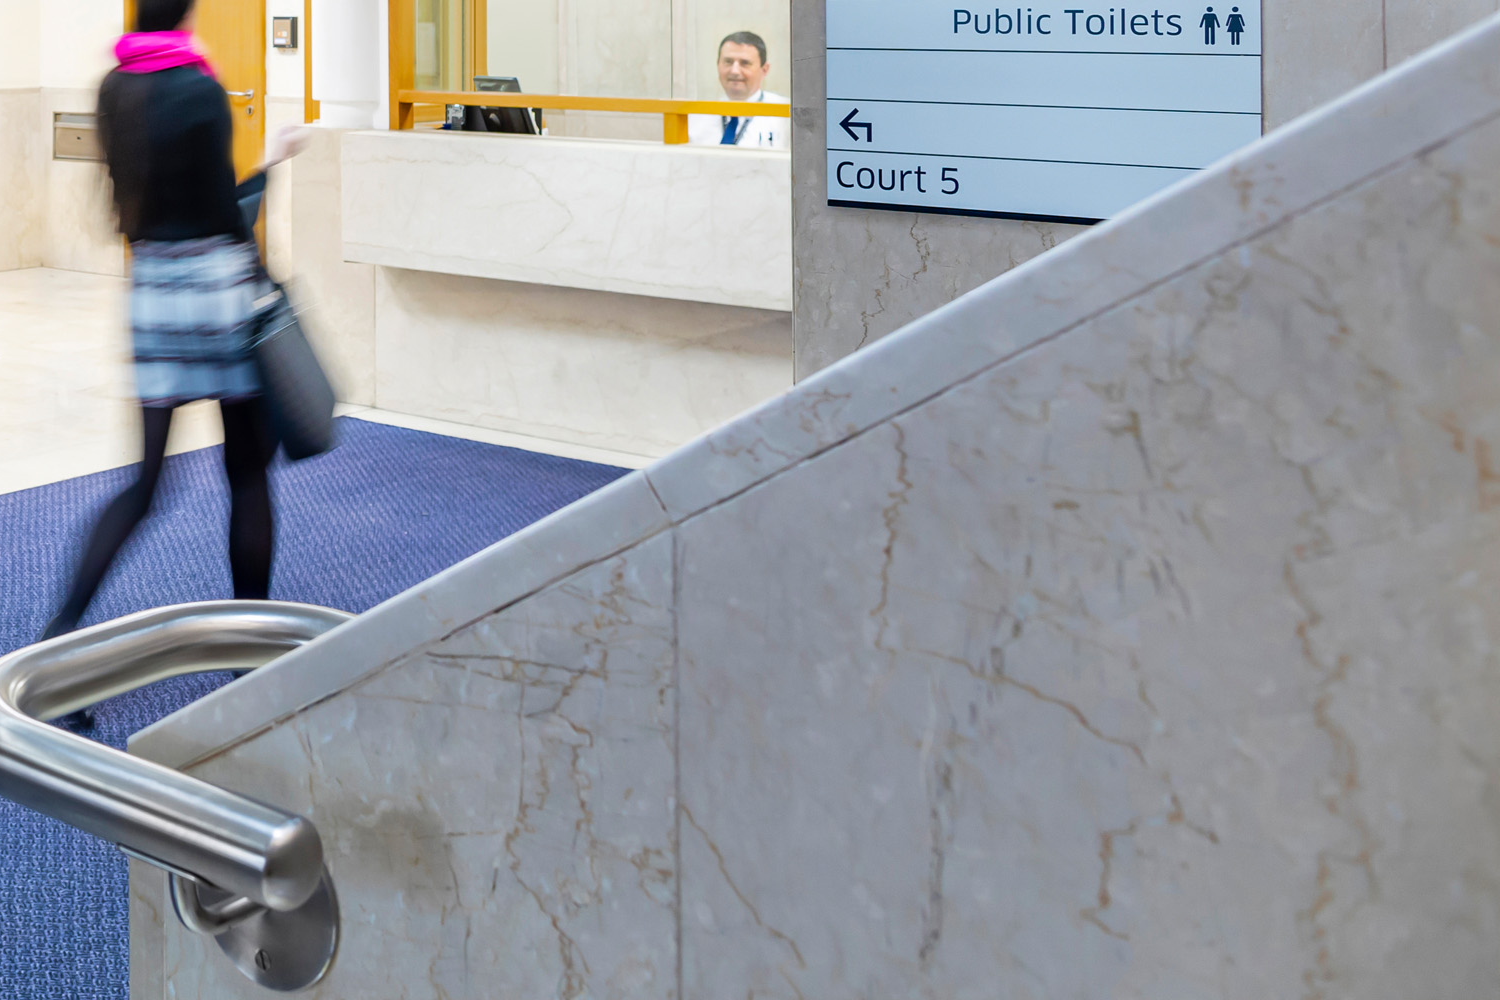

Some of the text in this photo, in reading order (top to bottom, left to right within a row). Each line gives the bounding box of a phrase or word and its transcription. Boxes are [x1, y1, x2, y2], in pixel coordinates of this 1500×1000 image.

[953, 8, 1182, 36] Public Toilets
[836, 160, 960, 195] Court 5
